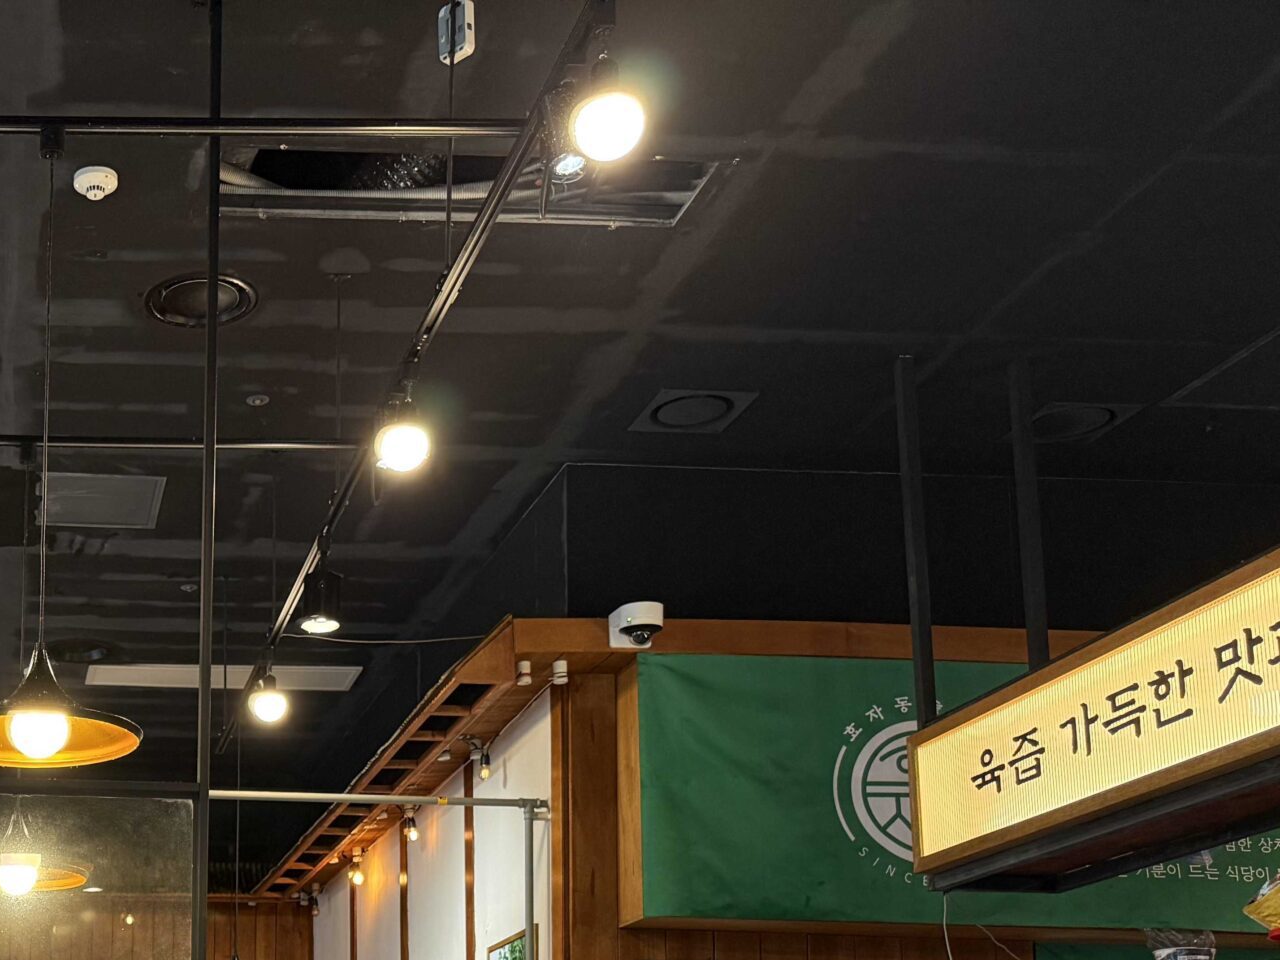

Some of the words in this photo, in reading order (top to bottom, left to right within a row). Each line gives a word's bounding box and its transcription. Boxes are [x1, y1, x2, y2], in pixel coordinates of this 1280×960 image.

[970, 726, 1046, 794] 육즙
[1059, 658, 1194, 757] 가득한
[1188, 864, 1220, 881] 드는
[1225, 865, 1270, 883] 식당이
